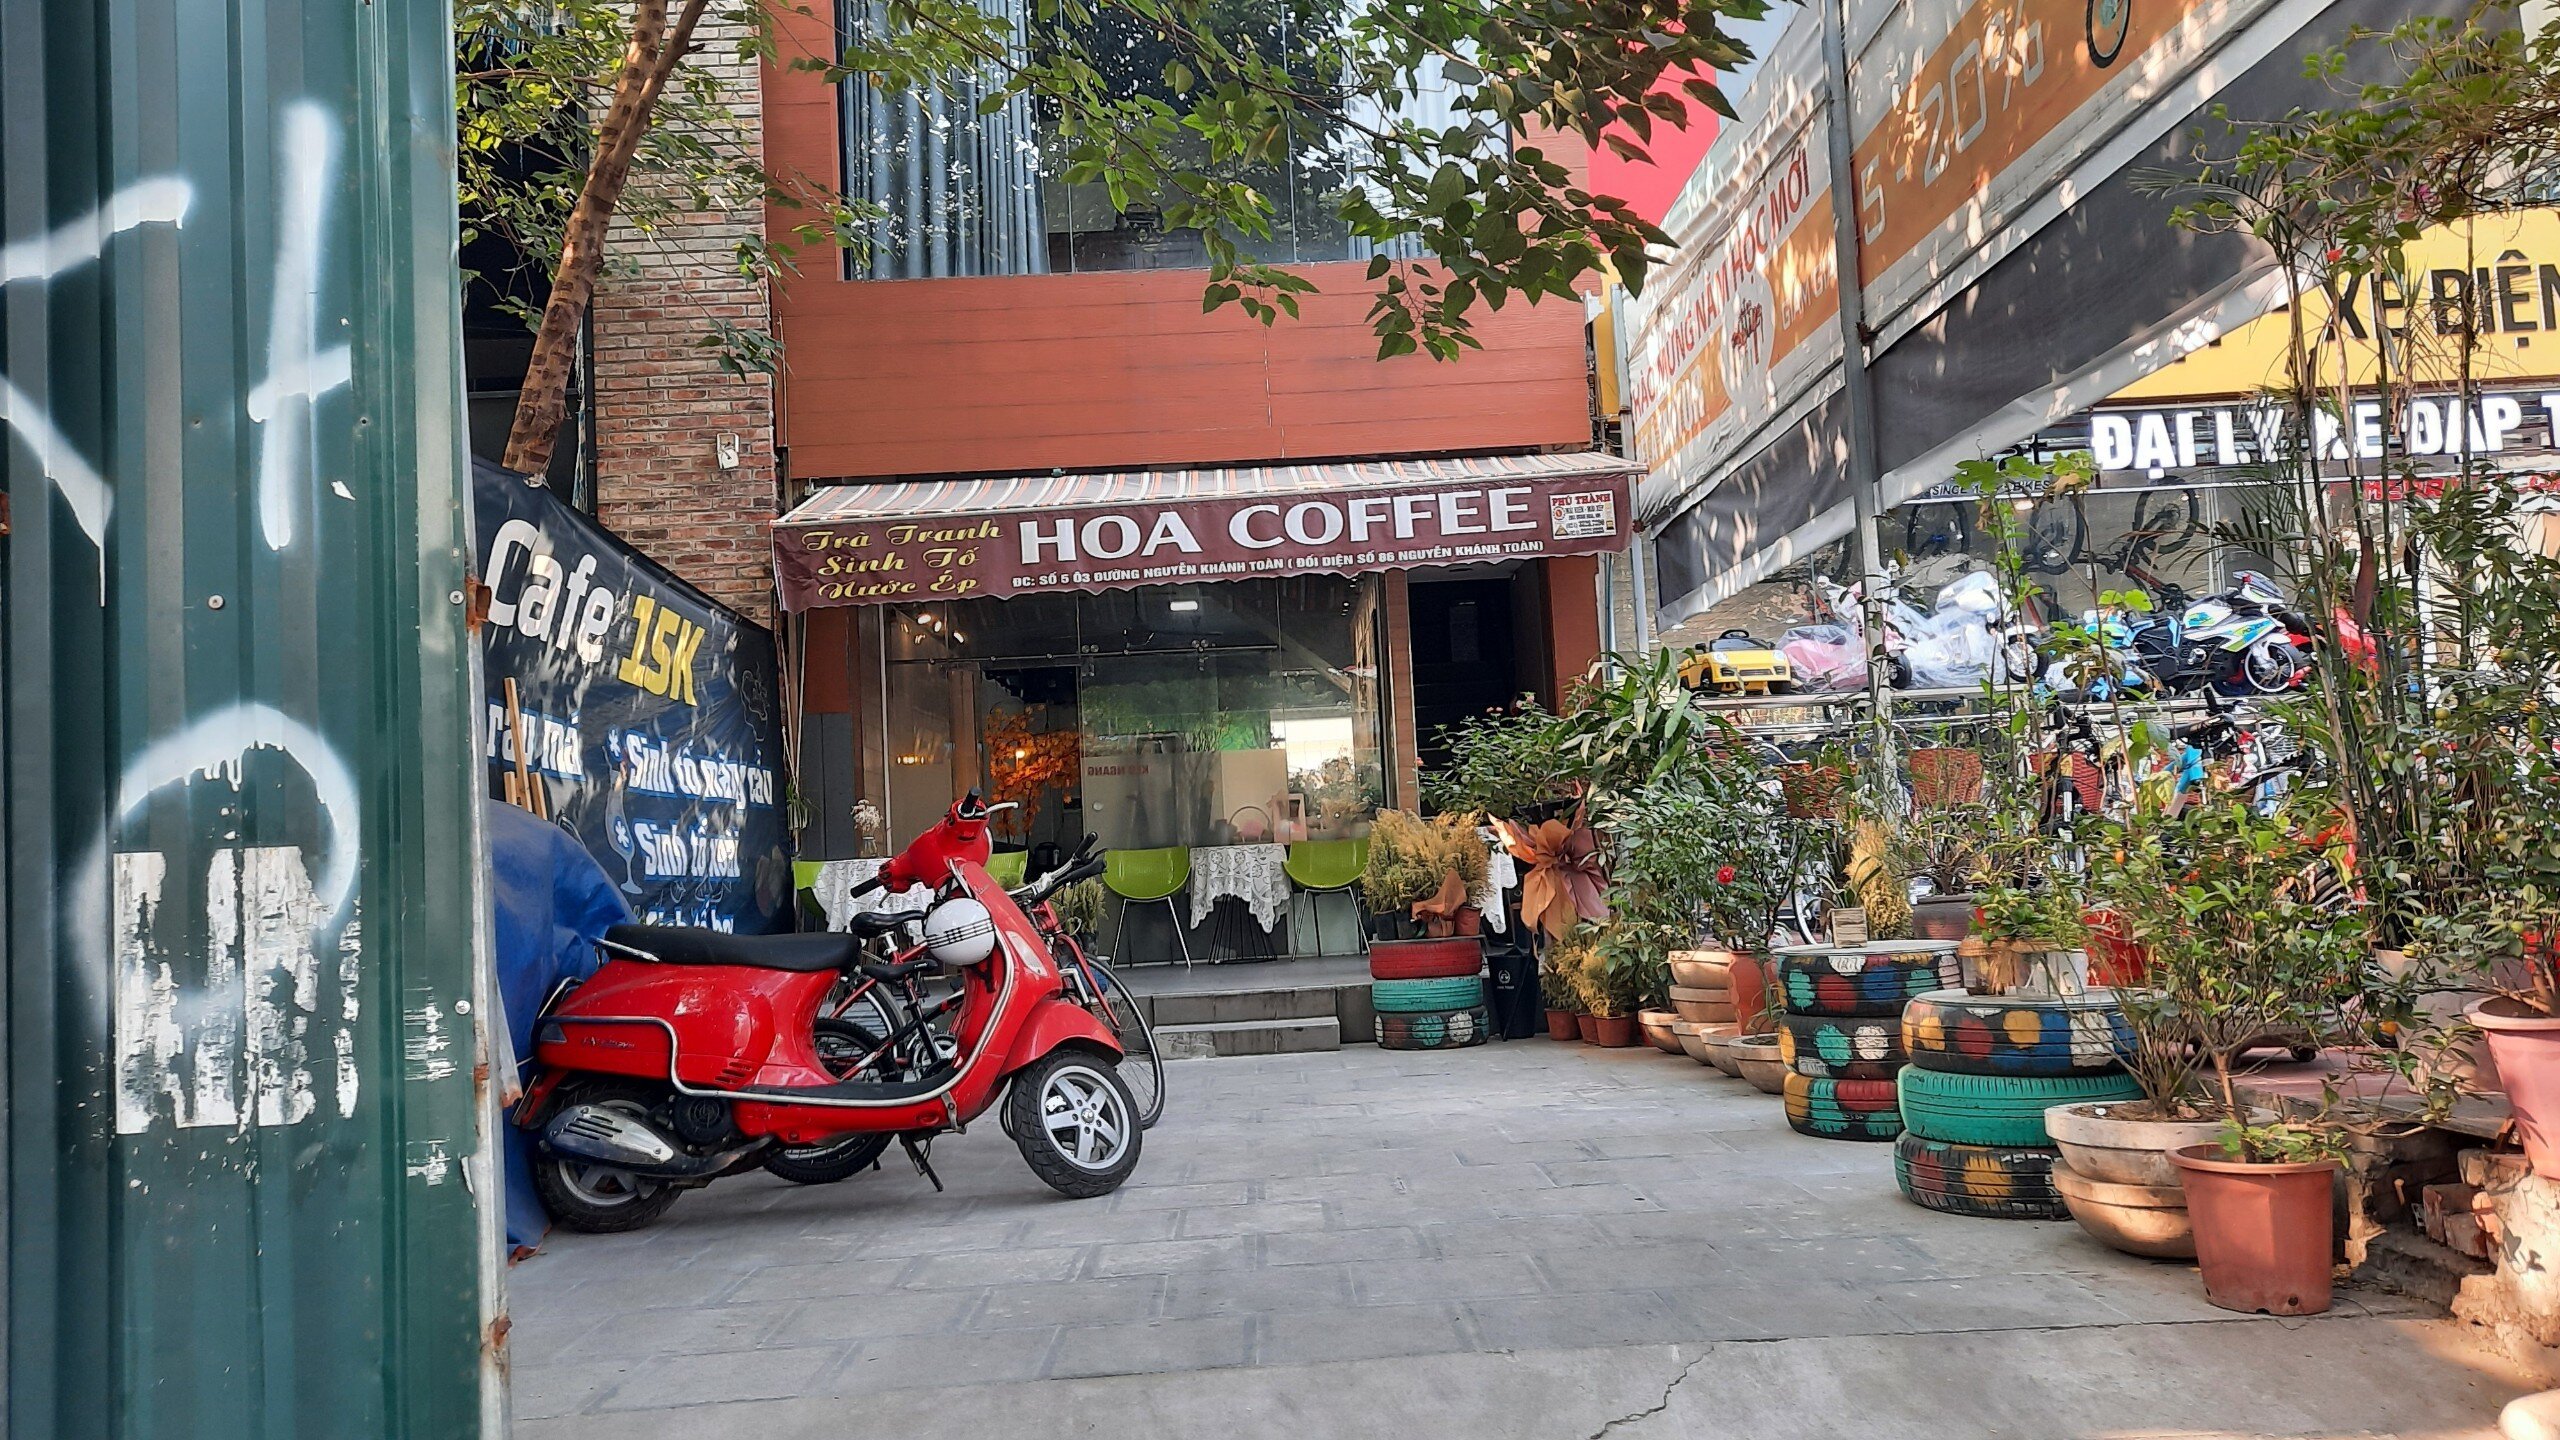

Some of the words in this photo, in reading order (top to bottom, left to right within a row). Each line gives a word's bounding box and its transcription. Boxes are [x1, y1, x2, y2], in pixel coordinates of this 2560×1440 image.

[1731, 204, 1768, 293] HỌC
[1770, 147, 1810, 241] MỚI
[2322, 265, 2411, 341] XE
[2091, 411, 2200, 479] ĐẠI
[2314, 402, 2384, 460] XE
[2401, 397, 2521, 464] ĐẠP
[1019, 511, 1202, 565] HOA
[1228, 486, 1539, 549] COFFEE
[1552, 495, 1573, 507] PHÚ
[1575, 492, 1611, 505] THÀNH
[802, 531, 872, 550] Trà
[886, 520, 1003, 546] Tranh
[818, 551, 909, 576] Sinh
[923, 546, 980, 568] Tố
[1012, 576, 1036, 588] ĐC:
[1038, 571, 1058, 586] SỐ
[1060, 574, 1070, 585] 5
[1094, 568, 1140, 582] ĐƯỜNG
[1200, 560, 1246, 574] KHÁNH
[1249, 557, 1284, 571] TOÀN
[1296, 552, 1319, 568] ĐỐI
[1322, 553, 1354, 569] DIỆN
[1356, 549, 1376, 564] SỐ
[1455, 541, 1501, 557] KHÁNH
[485, 518, 615, 665] Cafe
[618, 594, 706, 707] 15K
[818, 579, 919, 600] Nước
[930, 569, 981, 595] Ép
[541, 714, 582, 776] má
[626, 733, 675, 793] Sinh
[673, 739, 702, 797] tố
[634, 822, 687, 877] Sinh
[690, 817, 707, 877] tố
[708, 829, 741, 877] xoài
